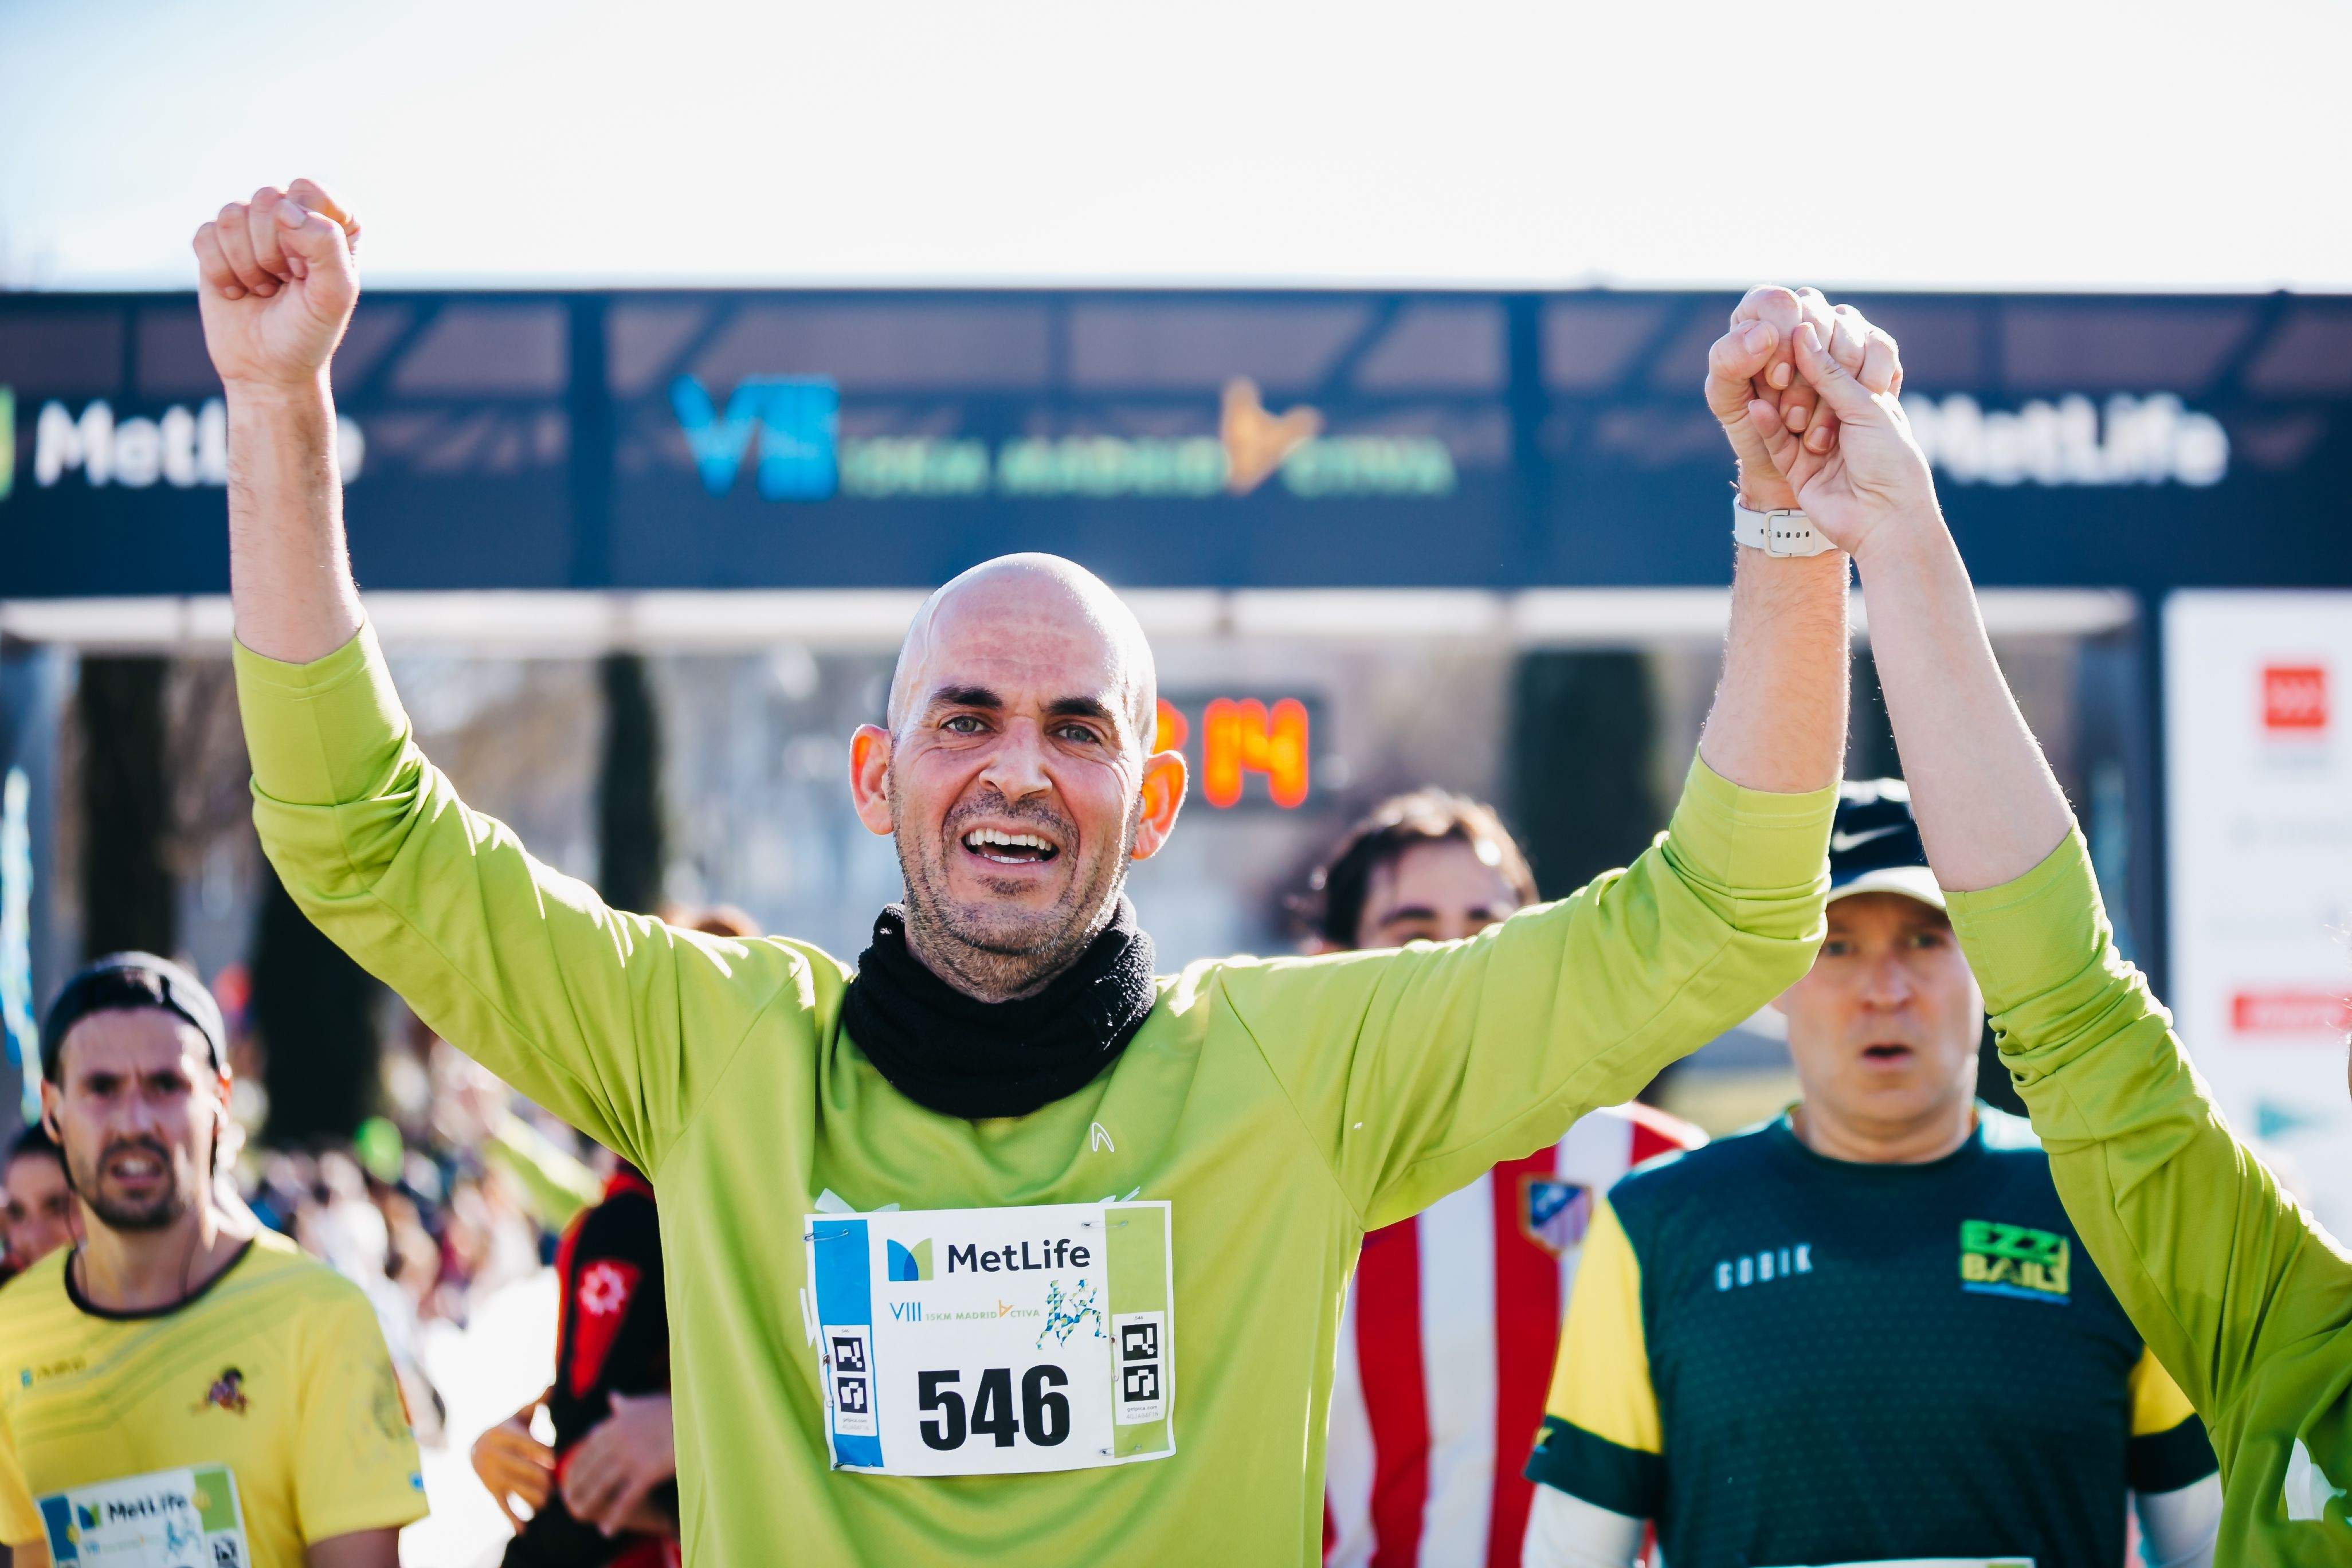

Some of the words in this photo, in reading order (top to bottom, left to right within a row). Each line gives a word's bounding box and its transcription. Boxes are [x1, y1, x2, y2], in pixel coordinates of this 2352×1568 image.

[947, 1238, 1091, 1273] MetLife
[889, 1302, 922, 1322] VIII
[926, 1312, 952, 1321] 15KM
[956, 1311, 998, 1320] MADRID
[918, 1365, 1071, 1451] 546
